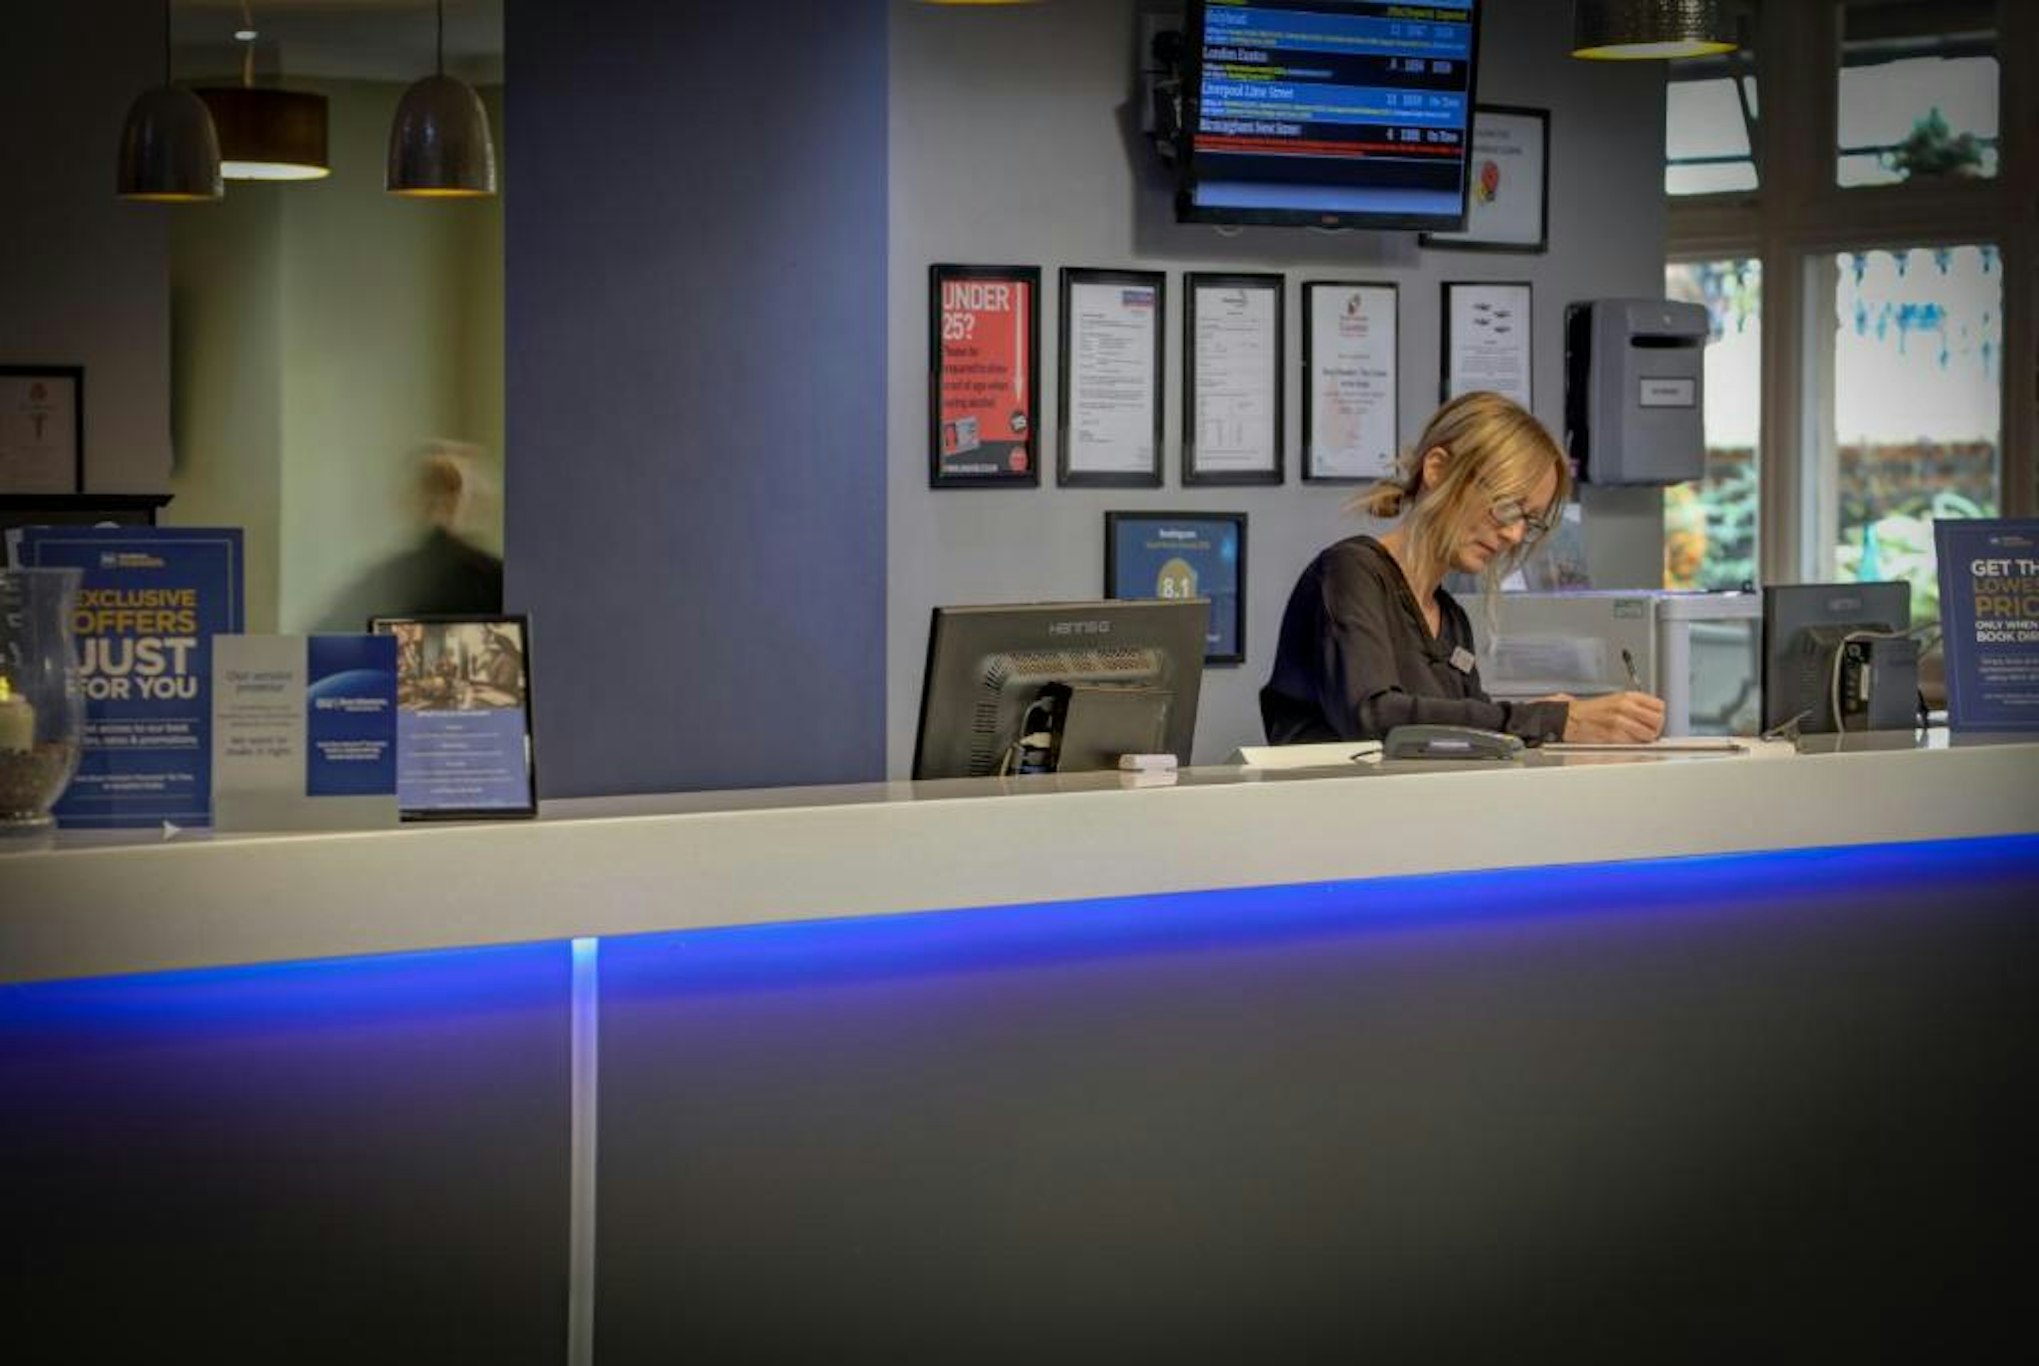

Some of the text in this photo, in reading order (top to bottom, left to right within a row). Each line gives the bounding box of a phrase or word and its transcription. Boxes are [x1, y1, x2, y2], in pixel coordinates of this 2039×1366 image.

[1202, 80, 1243, 98] Liverpool
[1268, 85, 1294, 99] Street
[943, 283, 1010, 310] UNDER
[943, 313, 975, 340] 25?
[1970, 559, 2012, 577] GET
[74, 589, 197, 607] EXCLUSIVE
[1163, 576, 1190, 599] 8.1
[69, 610, 197, 634] OFFERS
[1975, 619, 2004, 630] ONLY
[1976, 630, 2015, 643] BOOK
[78, 637, 198, 676] JUST
[66, 677, 198, 699] FOR YOU
